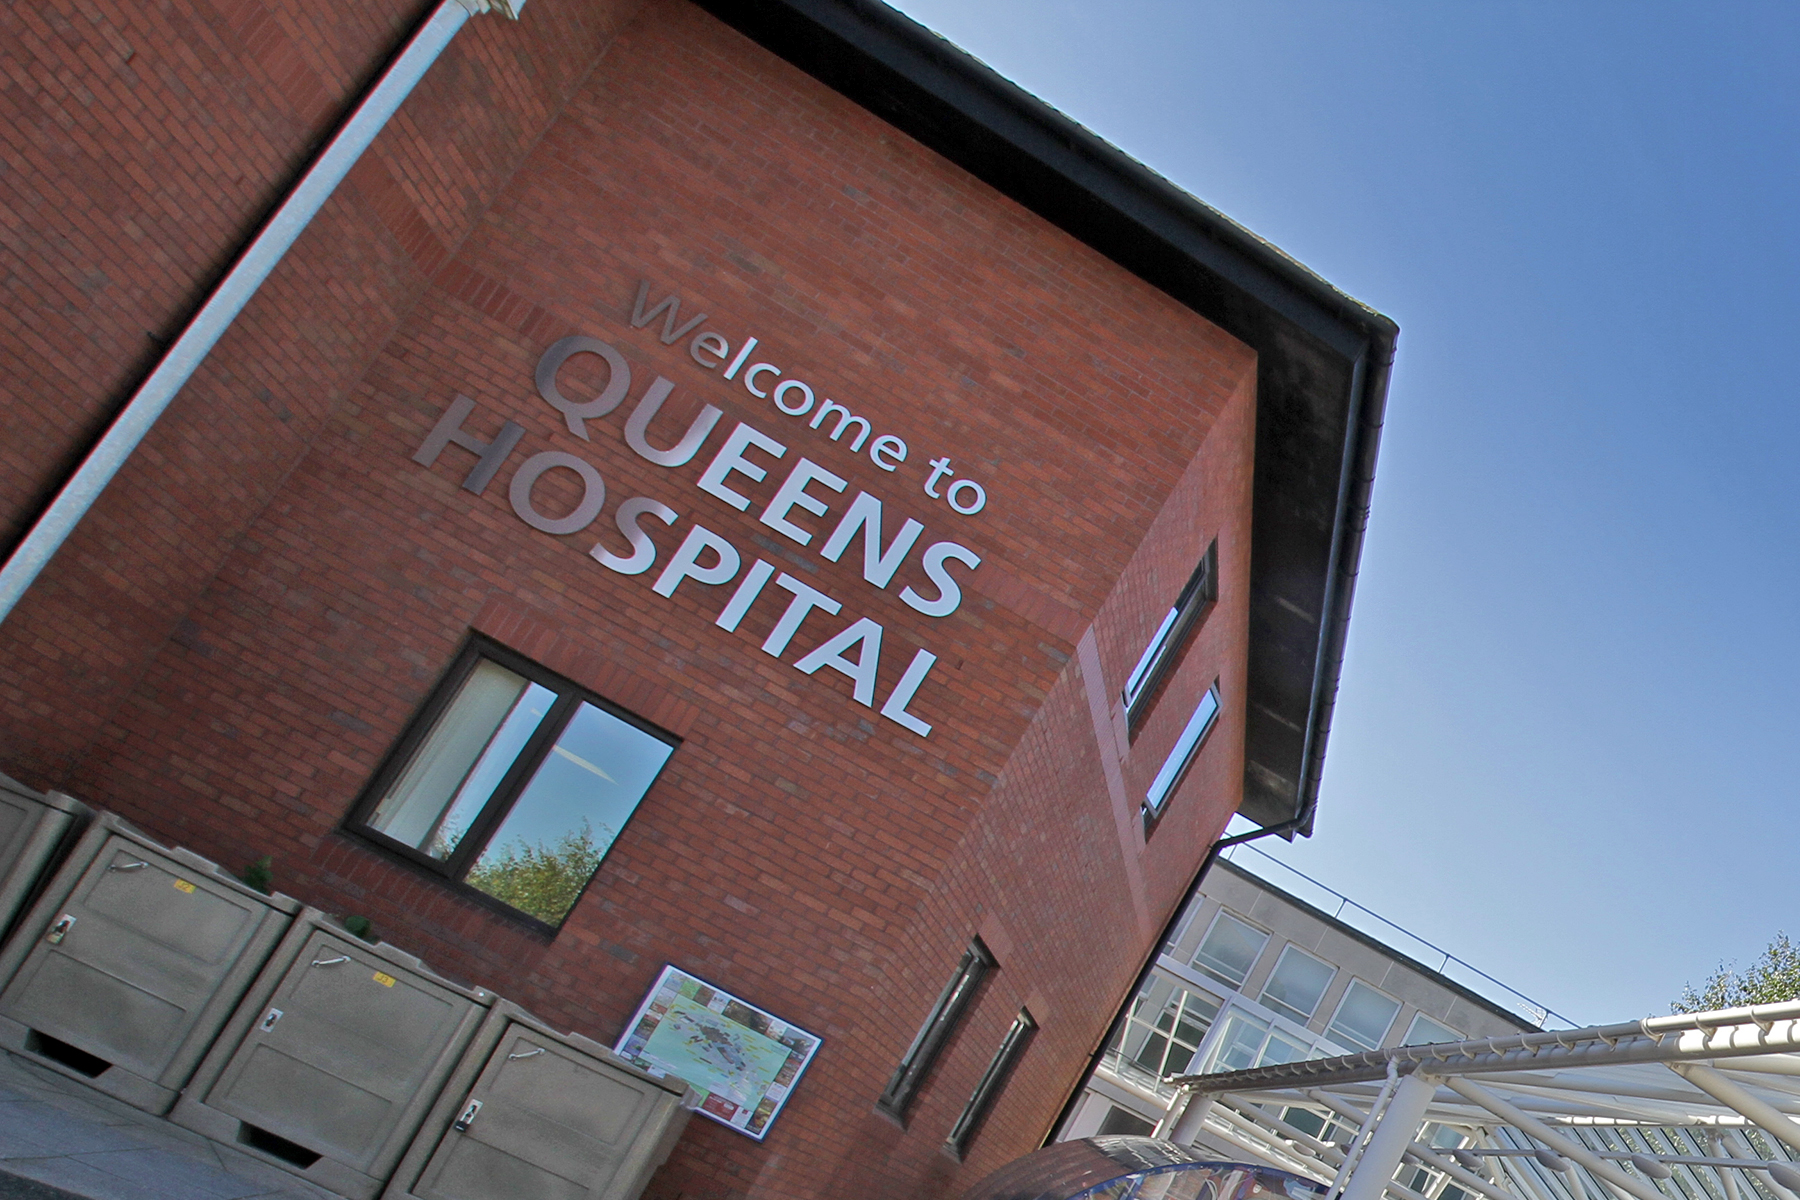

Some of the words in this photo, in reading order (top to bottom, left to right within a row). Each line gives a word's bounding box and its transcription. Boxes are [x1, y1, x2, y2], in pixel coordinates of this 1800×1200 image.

[534, 335, 982, 618] QUEENS
[630, 279, 909, 473] Welcome
[923, 456, 988, 516] to
[411, 394, 938, 738] HOSPITAL
